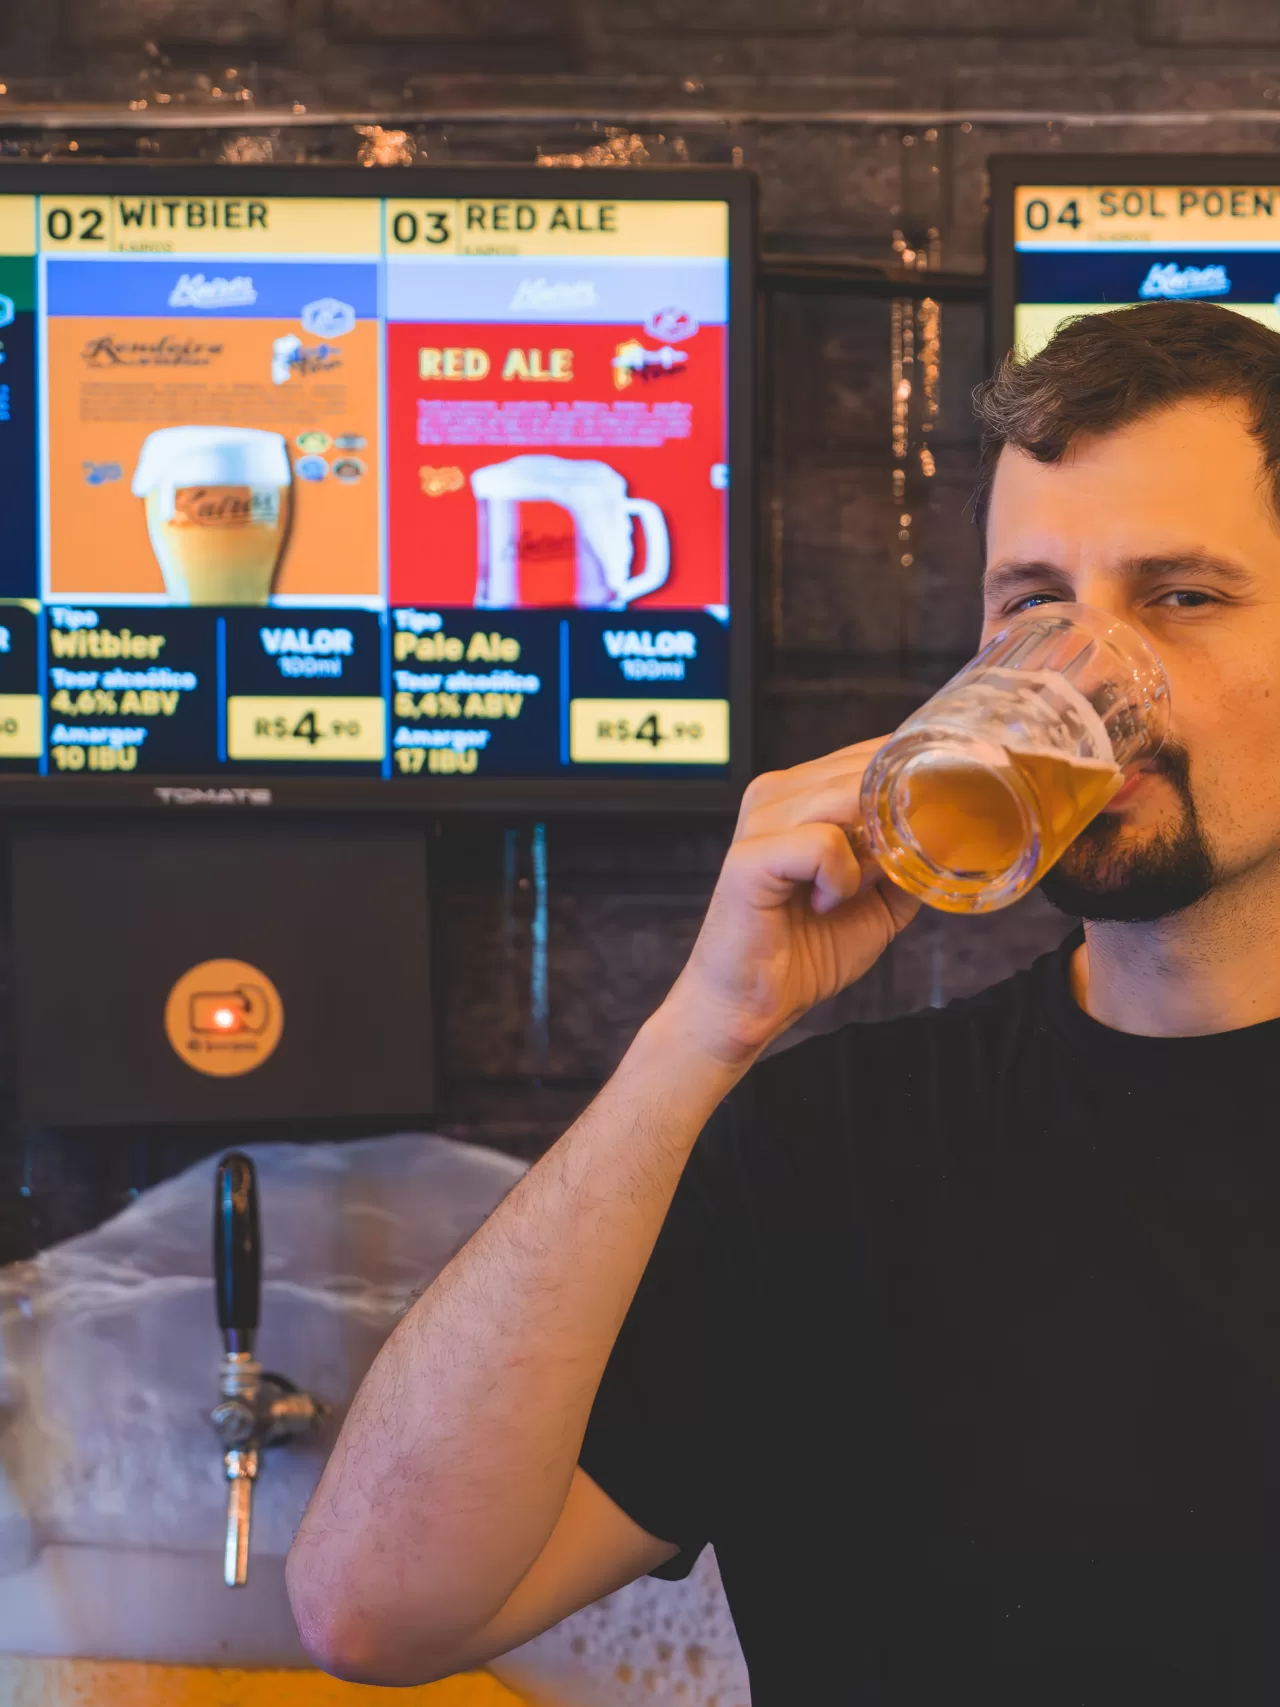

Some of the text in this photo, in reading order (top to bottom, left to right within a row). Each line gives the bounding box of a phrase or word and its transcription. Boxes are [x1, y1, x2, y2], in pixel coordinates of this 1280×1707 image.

[120, 200, 269, 229] WITBIER
[466, 203, 617, 232] RED ALE
[1026, 200, 1081, 231] 04
[1098, 190, 1166, 217] SOL
[48, 208, 106, 240] 02
[393, 212, 450, 245] 03
[418, 347, 574, 382] RED ALE
[51, 629, 165, 659] Witbier
[260, 627, 354, 655] VALOR
[394, 632, 520, 662] Pale Ale
[603, 630, 697, 658] VALOR
[120, 690, 180, 715] ABV
[463, 692, 524, 719] ABV
[52, 746, 86, 771] 10
[394, 748, 426, 774] 17
[156, 787, 272, 804] TOMATE
